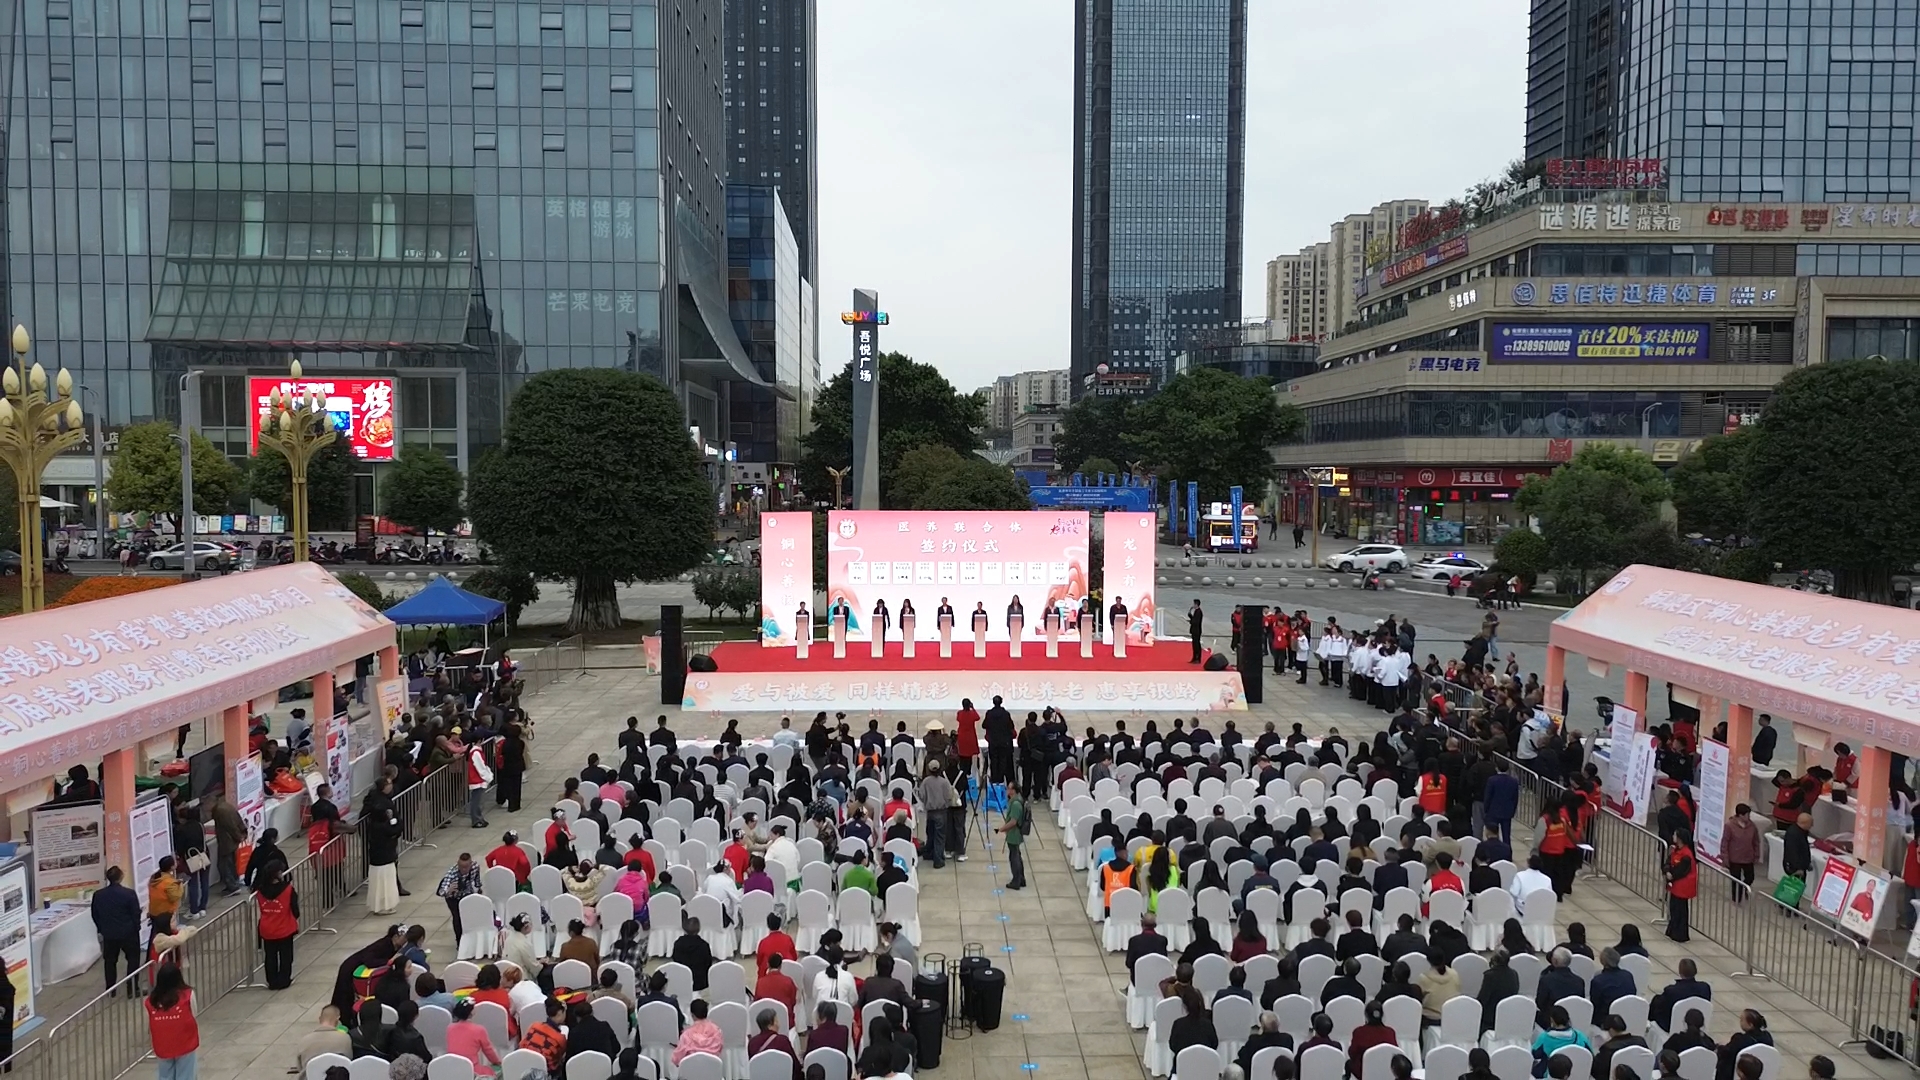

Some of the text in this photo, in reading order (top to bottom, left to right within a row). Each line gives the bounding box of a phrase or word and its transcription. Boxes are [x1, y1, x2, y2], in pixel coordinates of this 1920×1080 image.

[547, 199, 633, 219] 英格健身
[1539, 204, 1631, 231] 谜猴逃
[593, 220, 633, 239] 游泳
[1636, 216, 1682, 232] 探案馆
[1549, 283, 1717, 304] 思佰特迅捷体育
[1761, 289, 1777, 301] 3F
[548, 291, 636, 314] 芒果电竞
[1513, 340, 1571, 352] 13389610009
[859, 330, 872, 382] 吾悦广场
[1419, 357, 1481, 372] 黑马电竞
[1458, 471, 1496, 483] 美宜佳
[898, 520, 1023, 533] 医养联合体
[920, 538, 1001, 554] 签约仪式
[730, 681, 1200, 702] 爱与被爱 同样精彩 渝悦养老 惠享银龄
